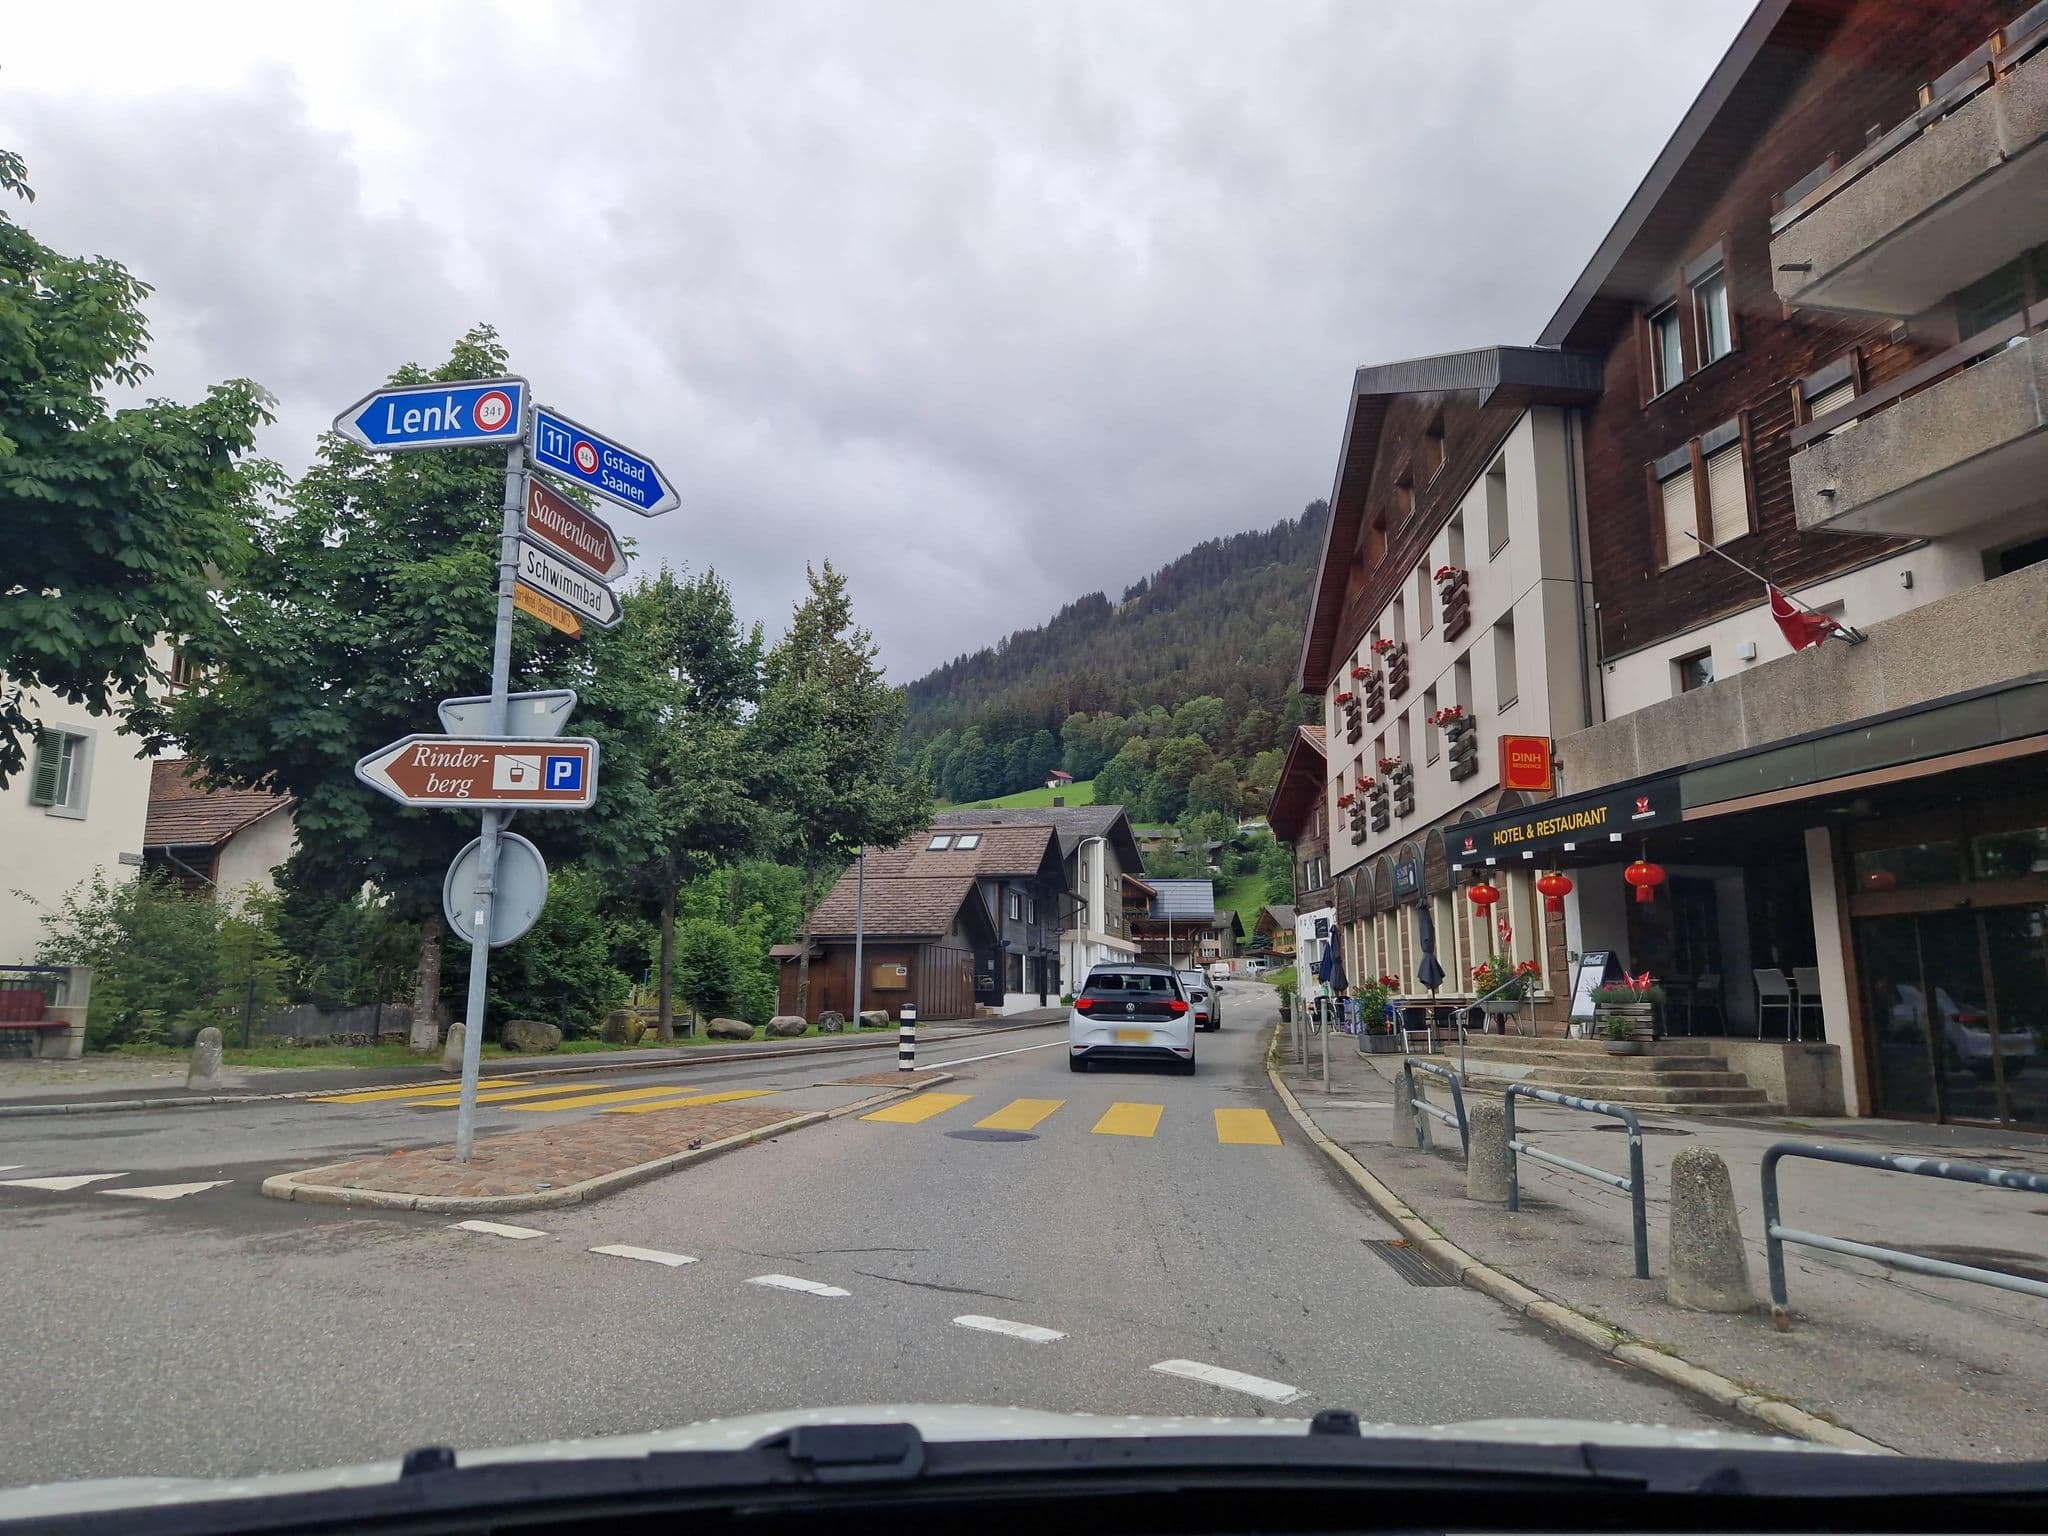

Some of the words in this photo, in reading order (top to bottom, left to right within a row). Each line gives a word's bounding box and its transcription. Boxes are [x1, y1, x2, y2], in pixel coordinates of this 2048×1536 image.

[386, 396, 462, 434] Lenk
[547, 430, 563, 455] 11
[603, 450, 645, 481] Gstaad
[602, 469, 645, 502] Saanen
[530, 490, 608, 562] Saanenland
[527, 550, 602, 611] Schwimmbad
[412, 746, 489, 768] Rinder-
[1512, 752, 1541, 763] DINH
[426, 773, 474, 798] berg
[553, 761, 572, 786] P
[1493, 827, 1524, 846] HOTEL
[1526, 823, 1534, 839] &
[1536, 806, 1608, 837] RESTAURANT
